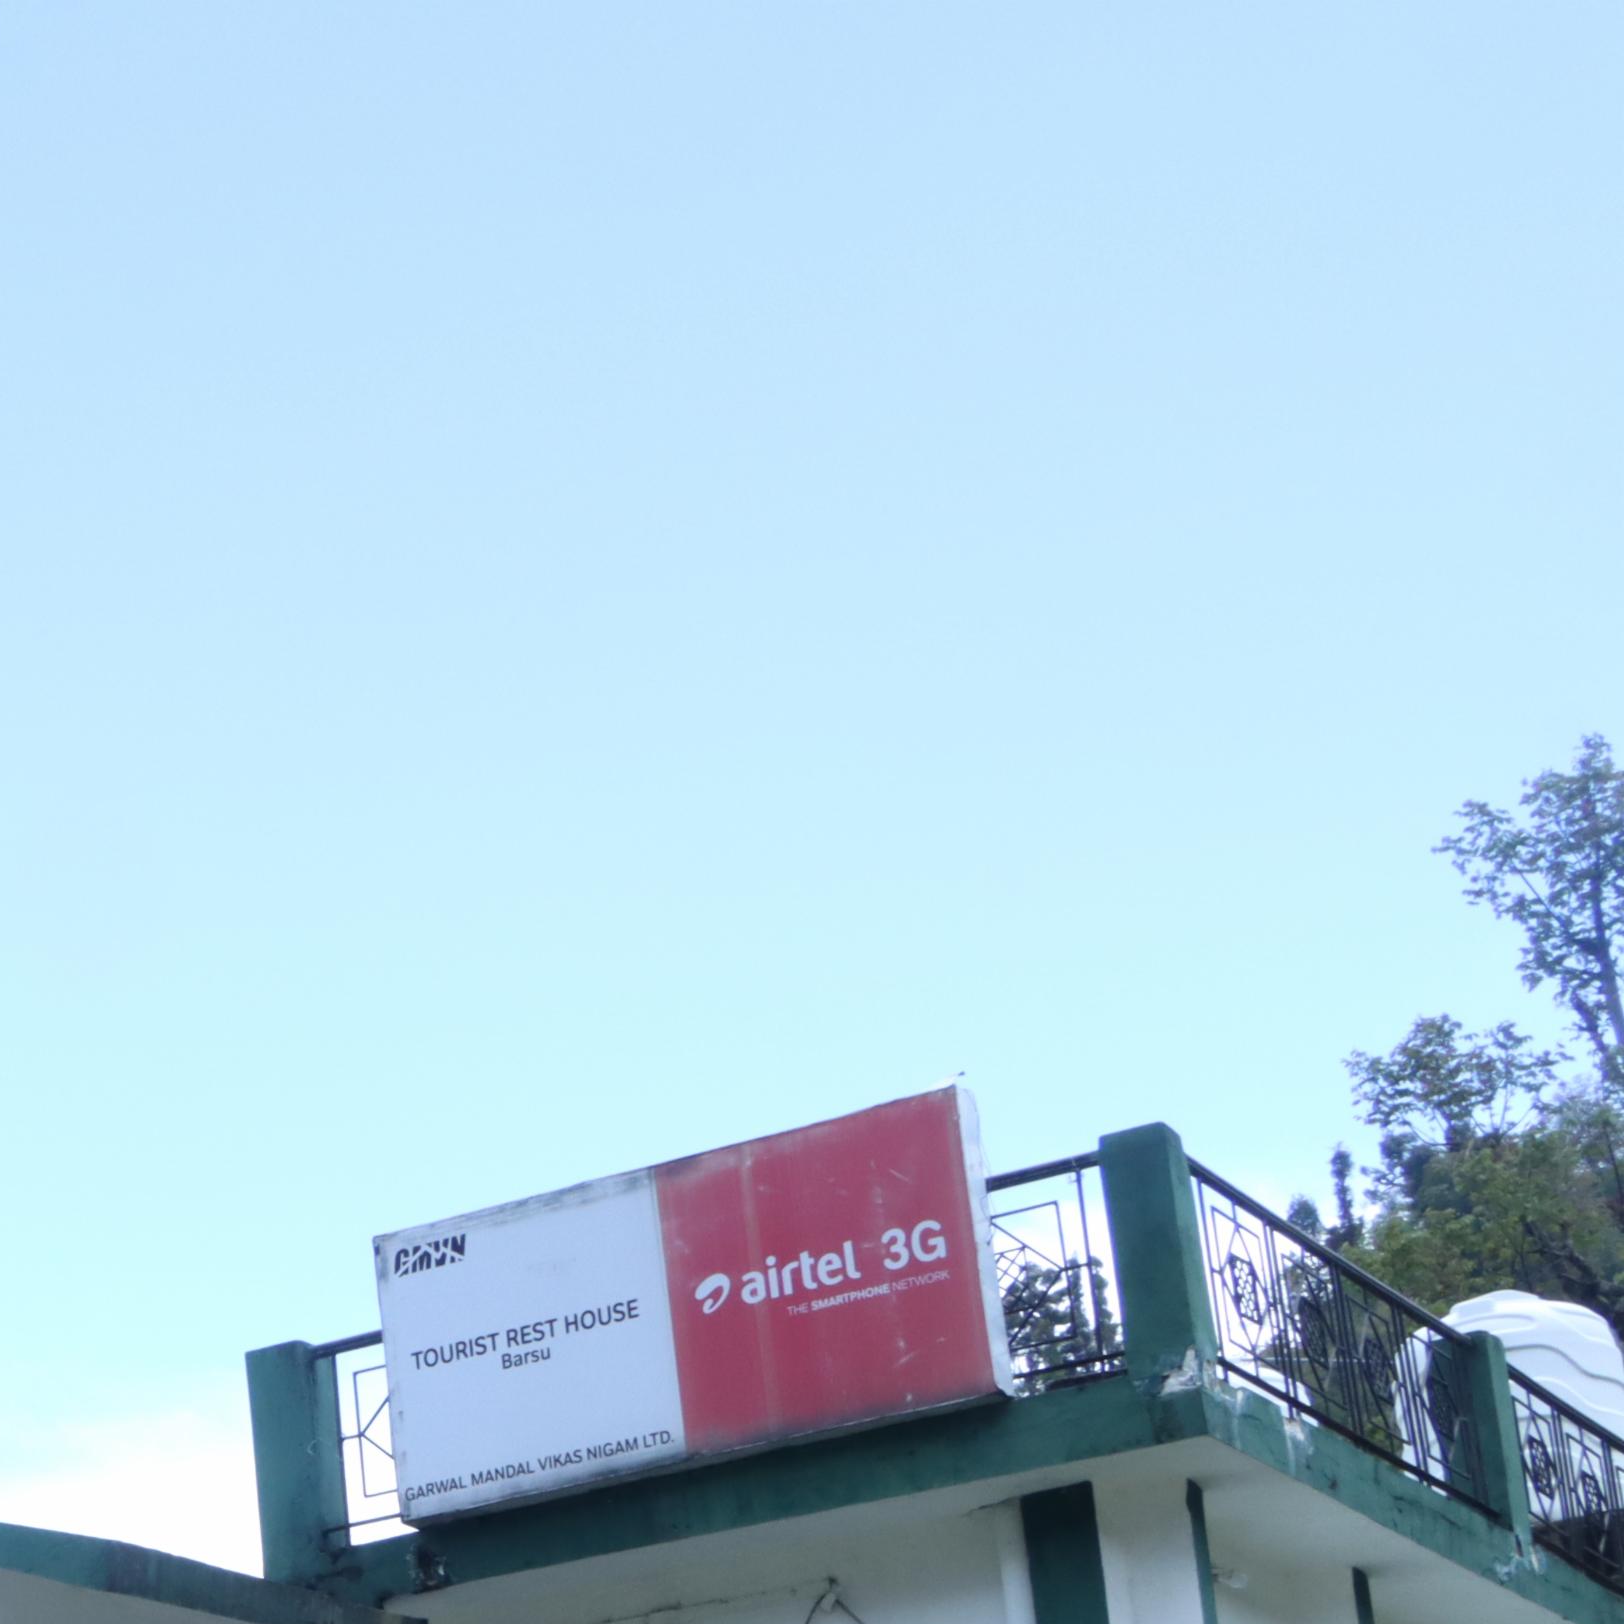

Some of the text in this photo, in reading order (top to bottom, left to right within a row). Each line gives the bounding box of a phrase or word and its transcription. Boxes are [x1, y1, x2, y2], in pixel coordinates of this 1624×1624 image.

[394, 1233, 466, 1278] GMVN
[741, 1220, 947, 1304] airtel 3G
[787, 1270, 950, 1317] THE SMARTPHONE NETWORK
[411, 1299, 640, 1370] TOURIST REST HOUSE
[501, 1347, 551, 1370] Barsu
[405, 1430, 675, 1501] GARWAL MANDAL VIKAS NIGAM LTD.
